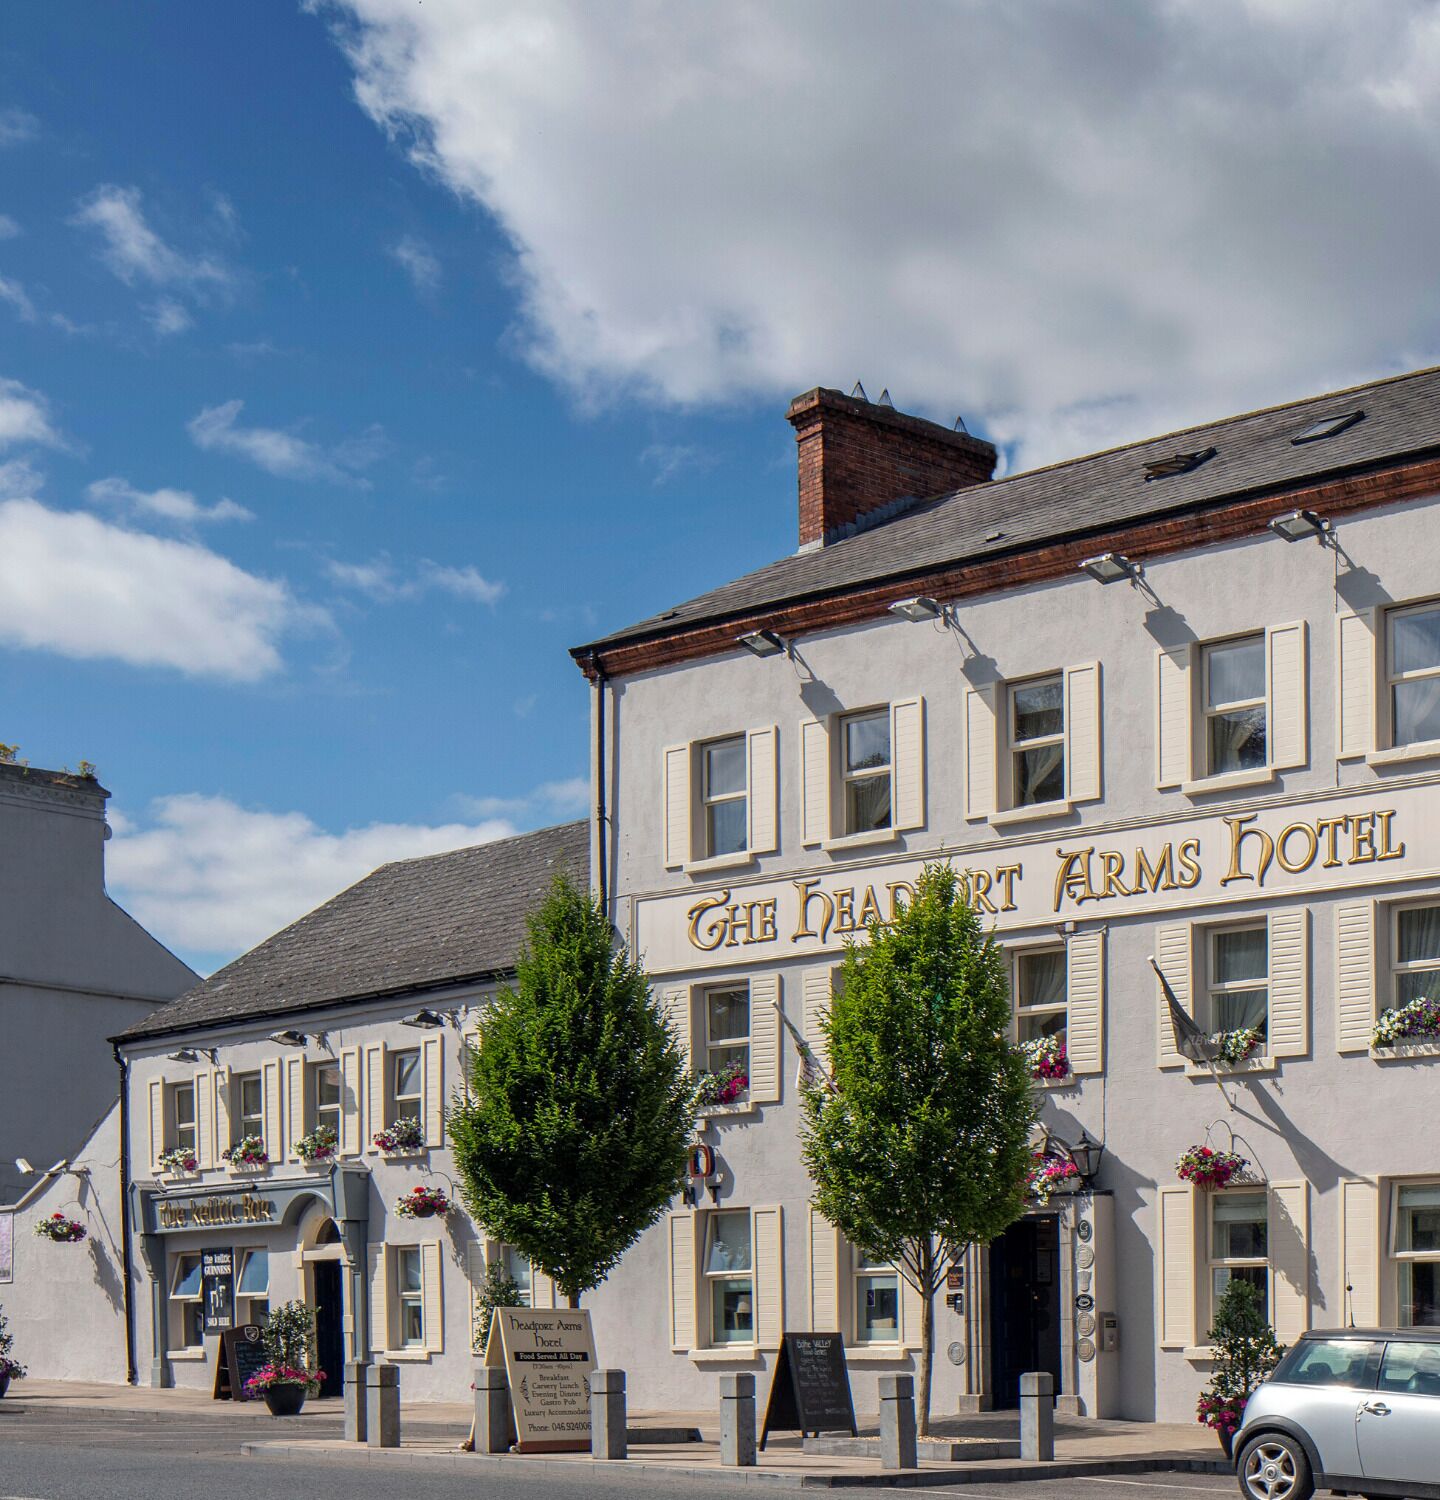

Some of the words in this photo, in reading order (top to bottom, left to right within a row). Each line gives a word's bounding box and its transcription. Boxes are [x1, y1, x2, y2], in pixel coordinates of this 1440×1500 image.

[688, 889, 777, 951] THE
[1054, 838, 1202, 912] ARMS
[1219, 809, 1405, 887] HOTEL
[204, 1265, 232, 1276] GUINNESS
[557, 1320, 583, 1331] Arms
[534, 1333, 563, 1347] Hotel
[520, 1352, 535, 1360] Food
[536, 1352, 557, 1360] Served
[559, 1352, 568, 1360] All
[570, 1352, 583, 1361] Day
[532, 1391, 557, 1399] Evening
[524, 1409, 546, 1417] Luxury
[548, 1408, 591, 1416] Accommodatio
